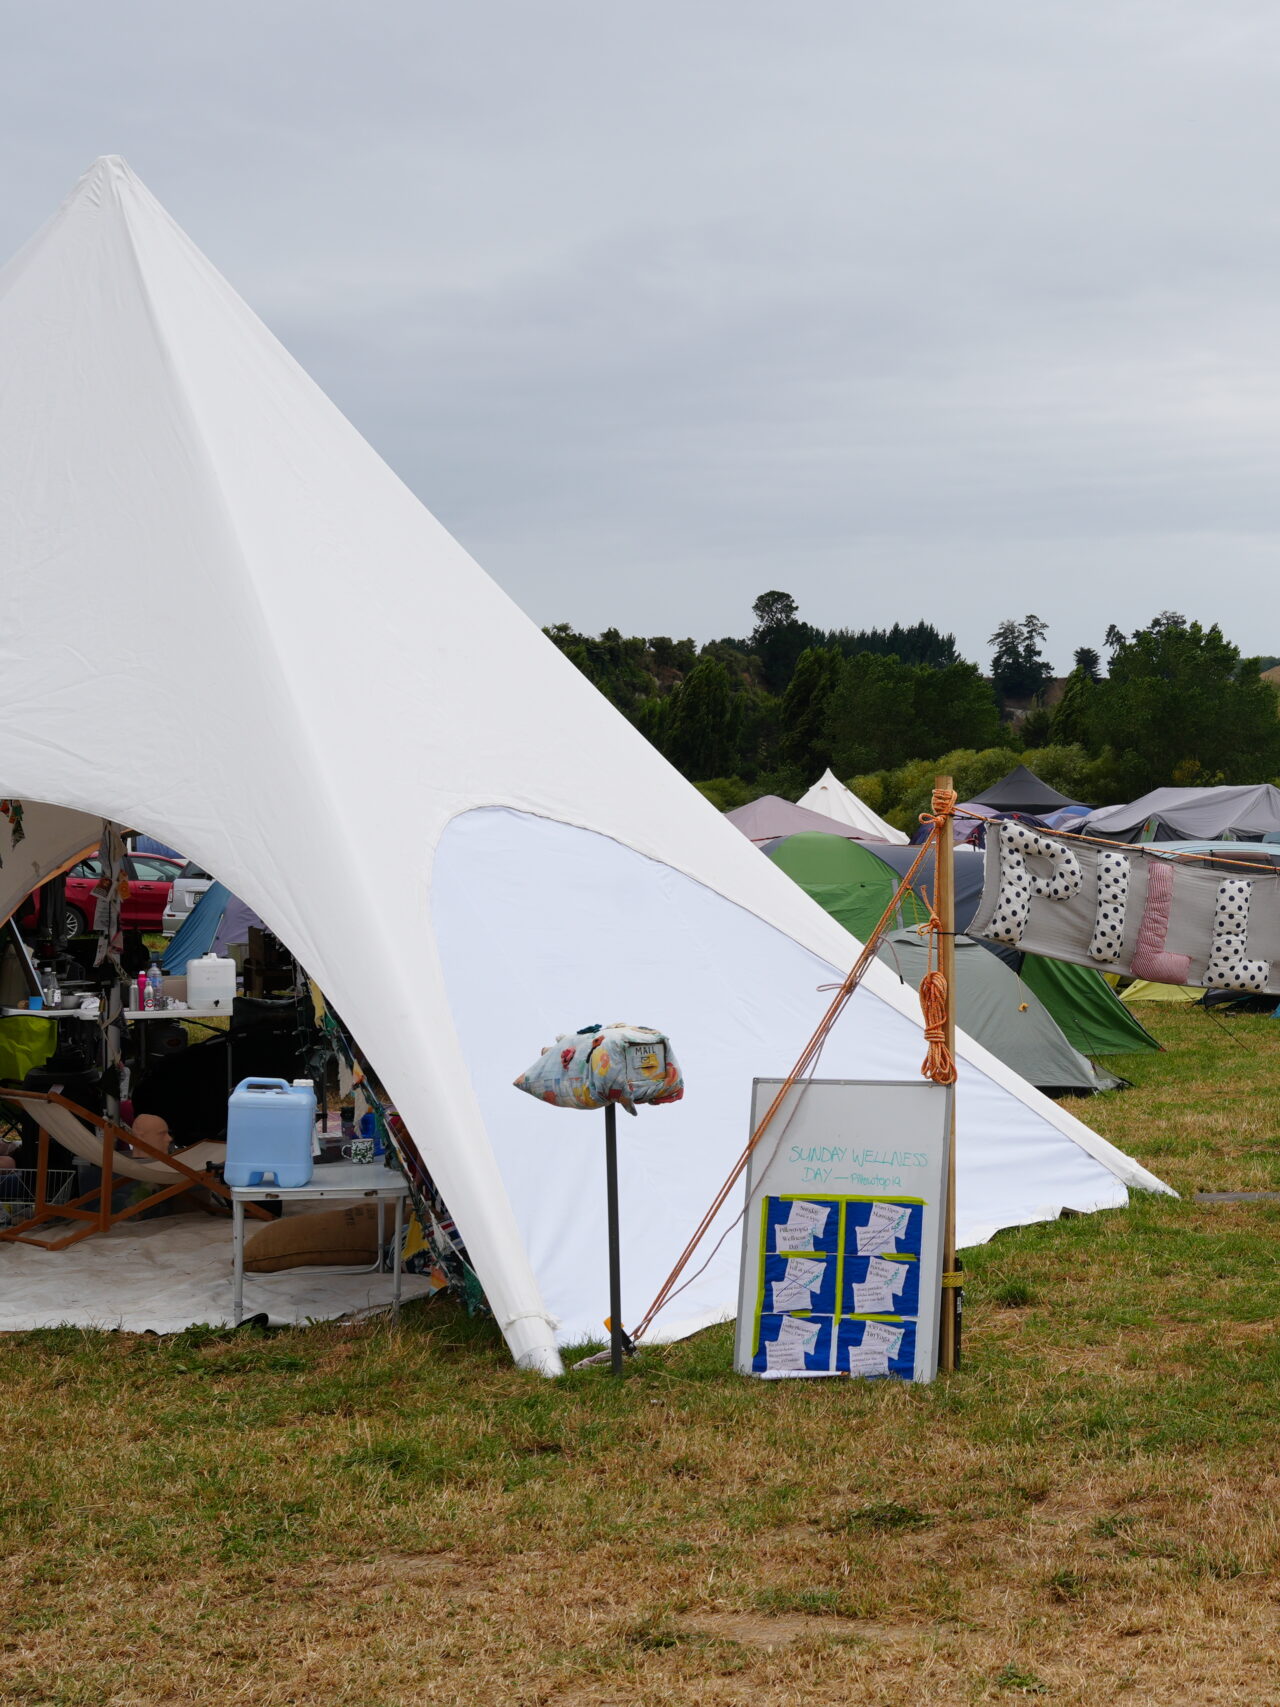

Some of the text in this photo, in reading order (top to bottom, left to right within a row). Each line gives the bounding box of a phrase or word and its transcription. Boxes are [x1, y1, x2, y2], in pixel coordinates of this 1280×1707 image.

[635, 1045, 657, 1056] MAIL
[788, 1145, 929, 1168] SUNDAY WELLNESS
[801, 1166, 832, 1183] DAY
